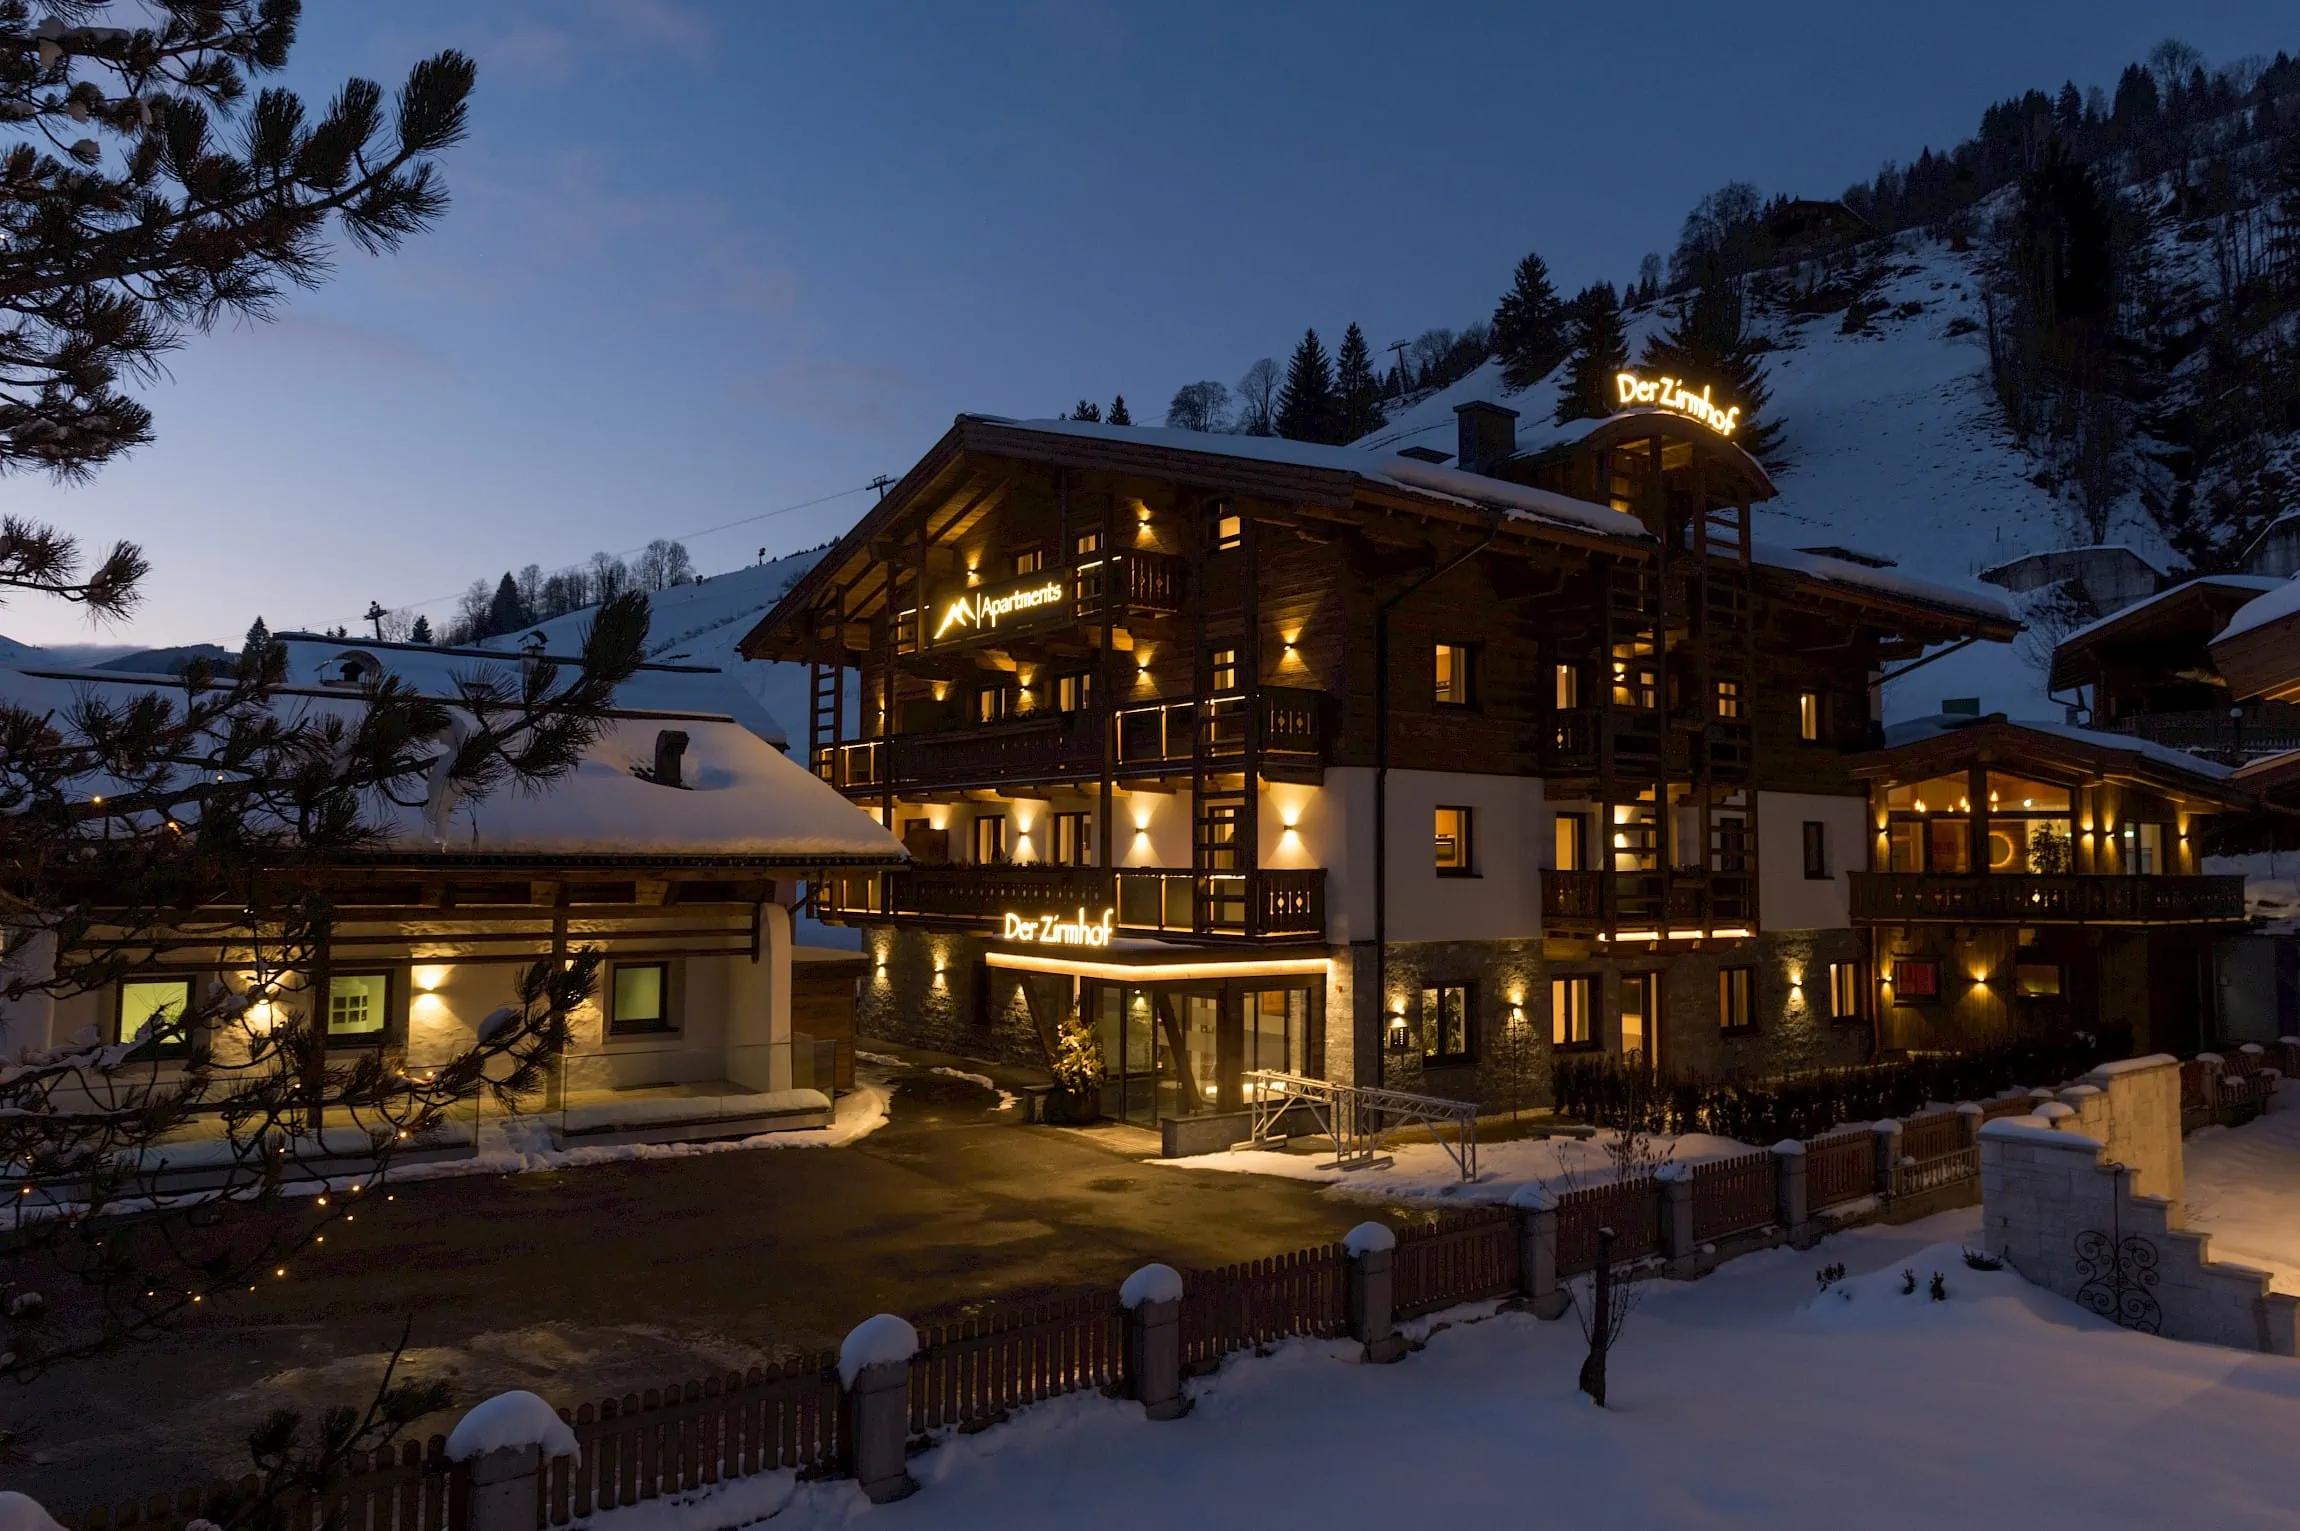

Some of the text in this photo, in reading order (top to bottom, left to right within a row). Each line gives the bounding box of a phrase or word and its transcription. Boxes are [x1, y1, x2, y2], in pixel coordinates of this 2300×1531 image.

[1617, 373, 1739, 436] Der Zirmhof
[981, 582, 1062, 628] Apartments
[1004, 907, 1114, 946] Der Zirmhof
